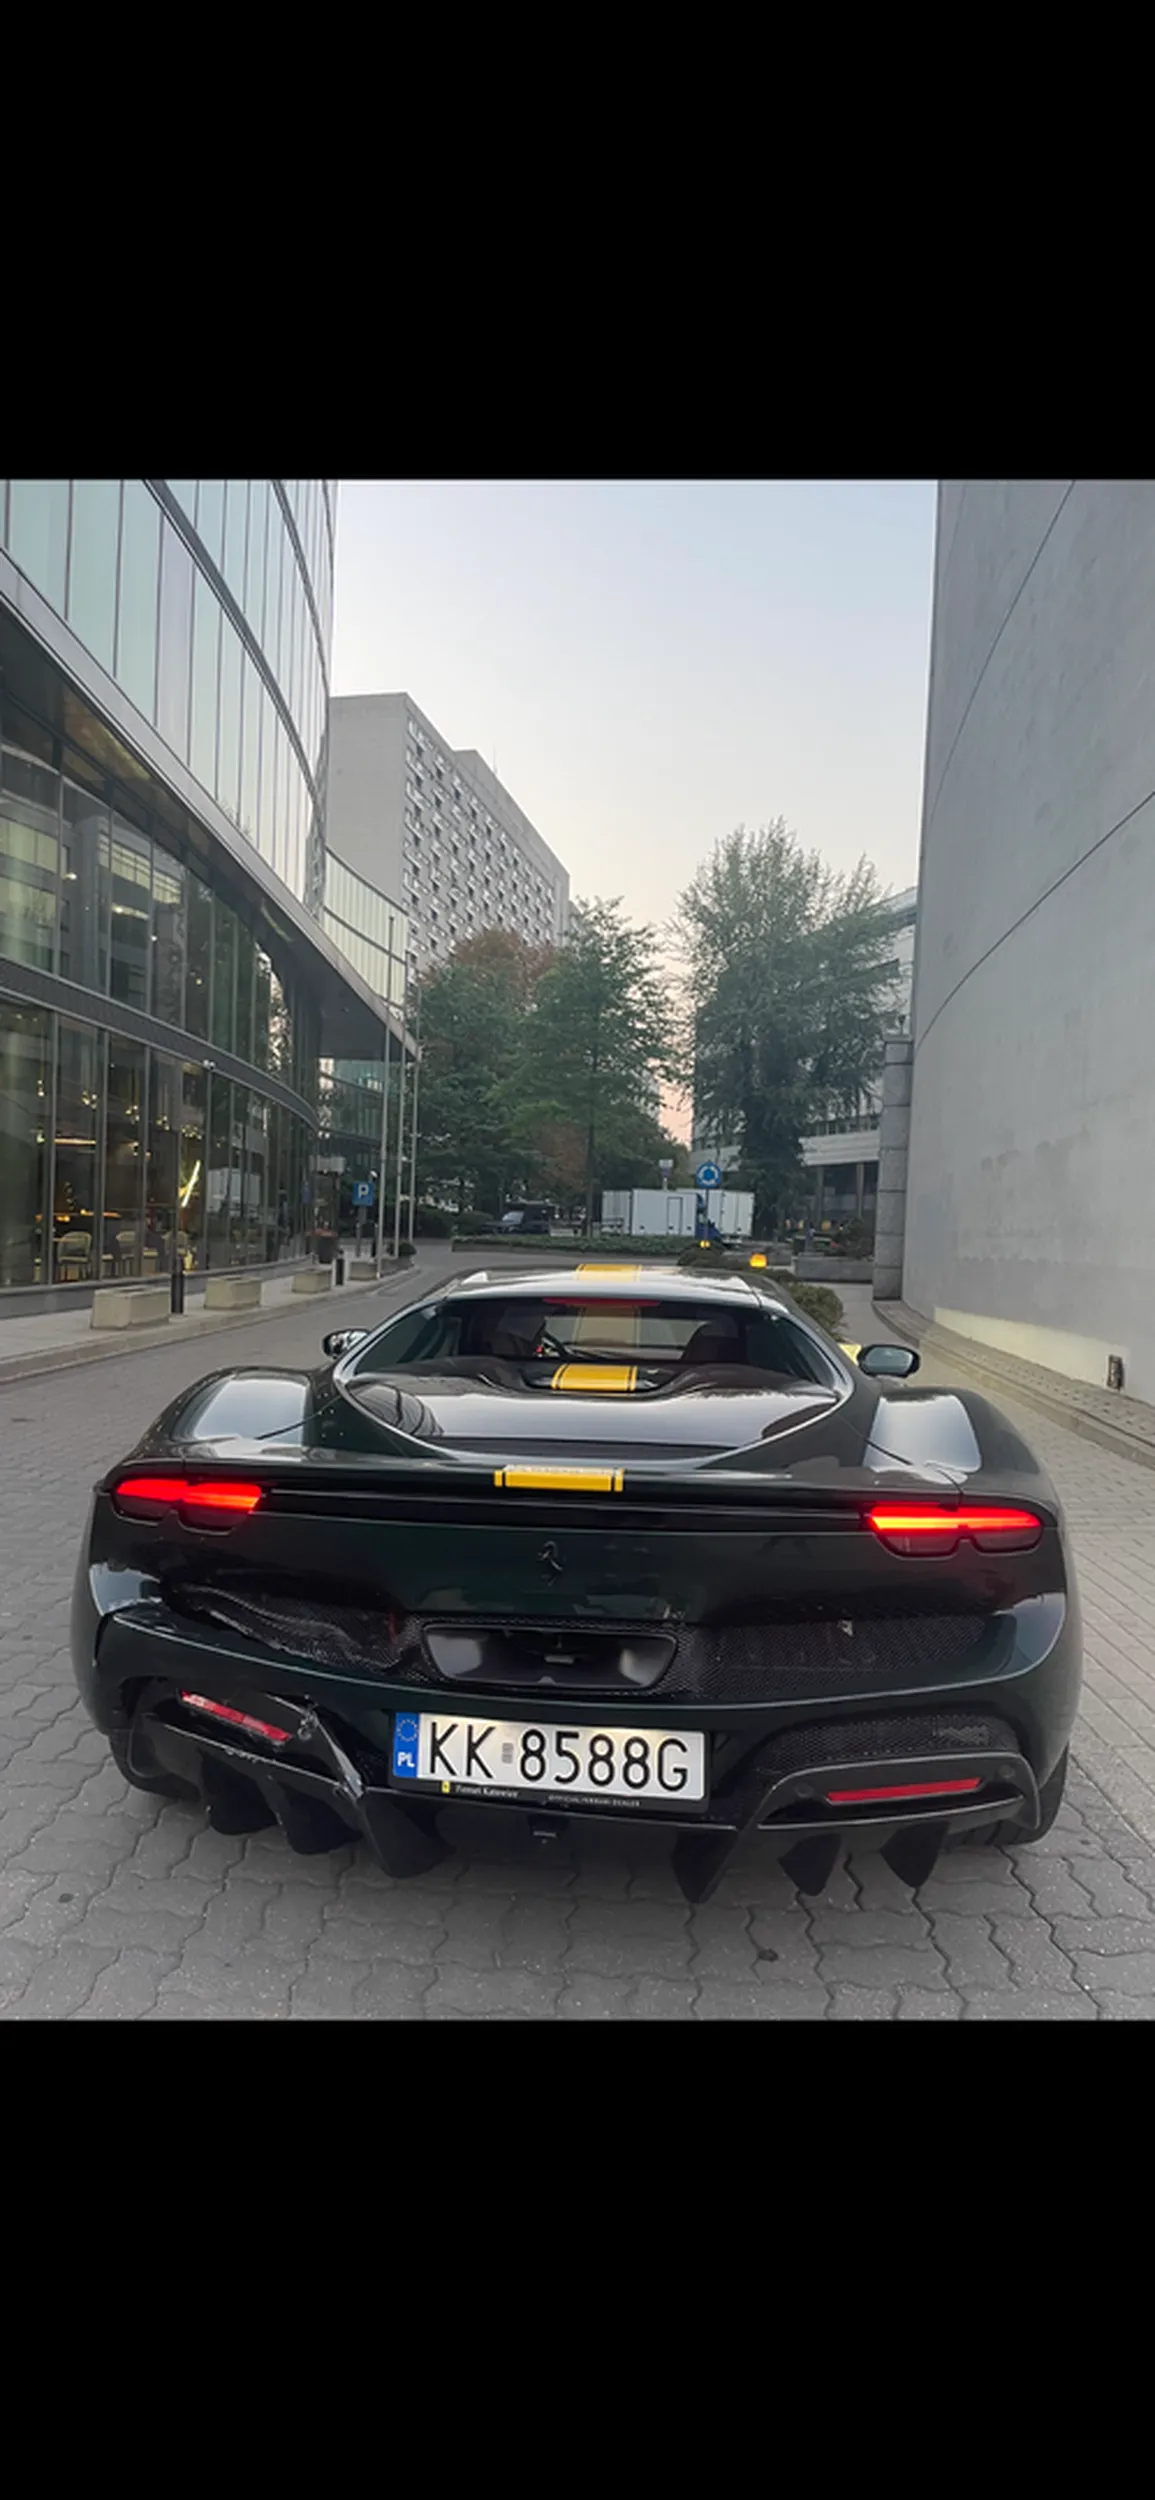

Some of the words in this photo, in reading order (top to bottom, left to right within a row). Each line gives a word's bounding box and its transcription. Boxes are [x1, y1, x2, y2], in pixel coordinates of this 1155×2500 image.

[358, 1183, 369, 1199] P
[397, 1751, 416, 1768] PL
[430, 1721, 496, 1779] KK
[520, 1728, 688, 1792] 8588G
